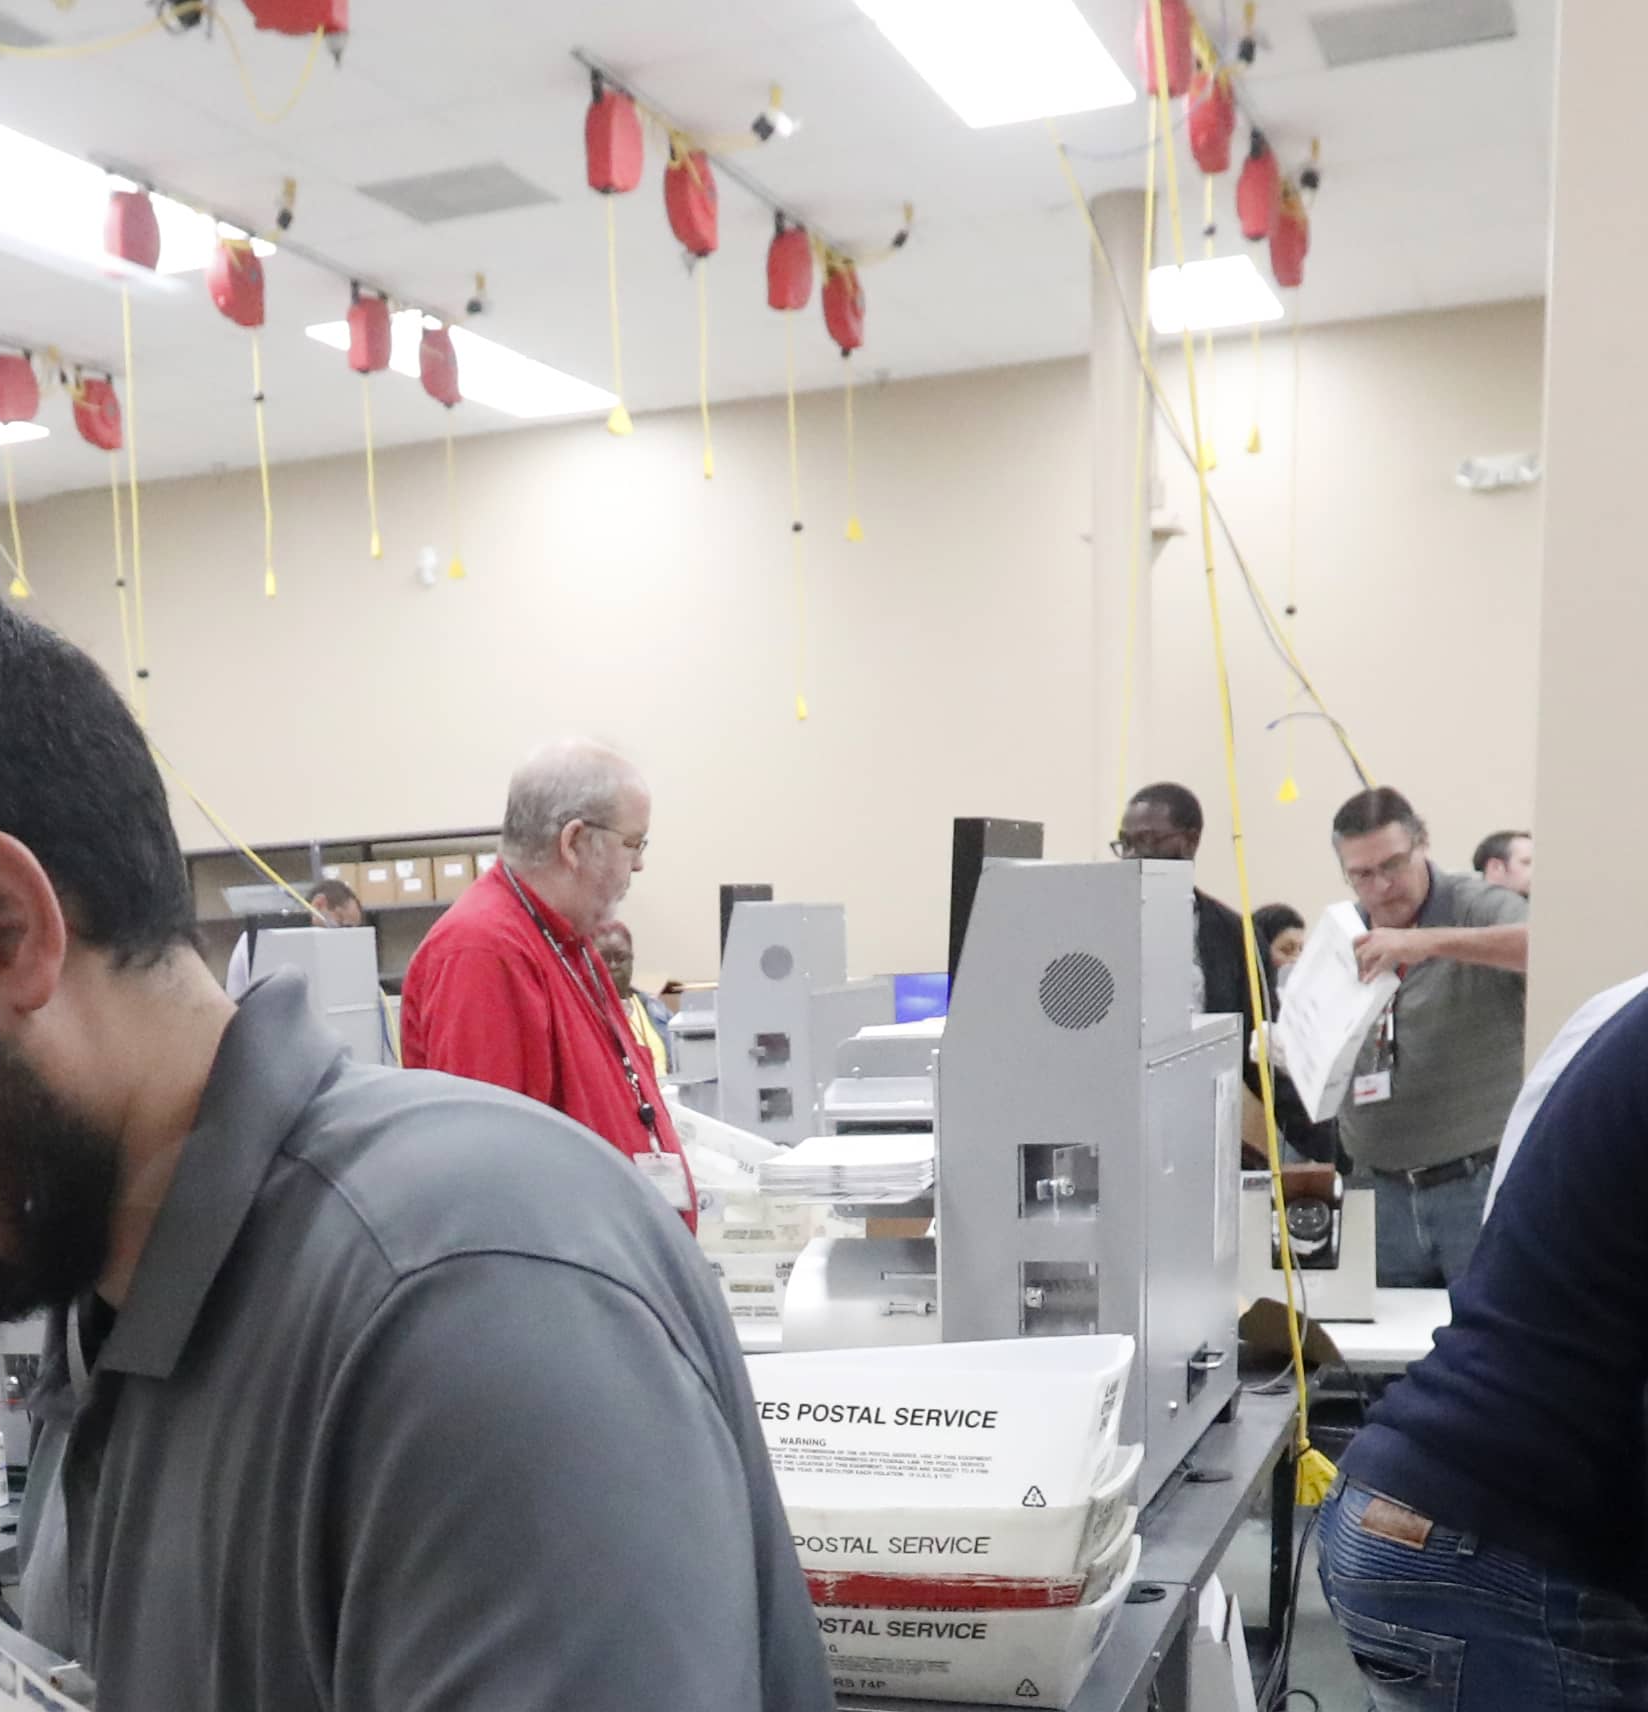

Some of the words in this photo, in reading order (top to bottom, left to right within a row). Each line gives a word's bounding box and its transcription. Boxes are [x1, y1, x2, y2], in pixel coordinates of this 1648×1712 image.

[797, 1402, 887, 1425] POSTAL
[894, 1407, 998, 1429] SERVICE
[780, 1437, 827, 1447] WARNING
[793, 1535, 878, 1554] POSTAL
[888, 1536, 992, 1554] SERVICE
[887, 1621, 988, 1640] SERVICE
